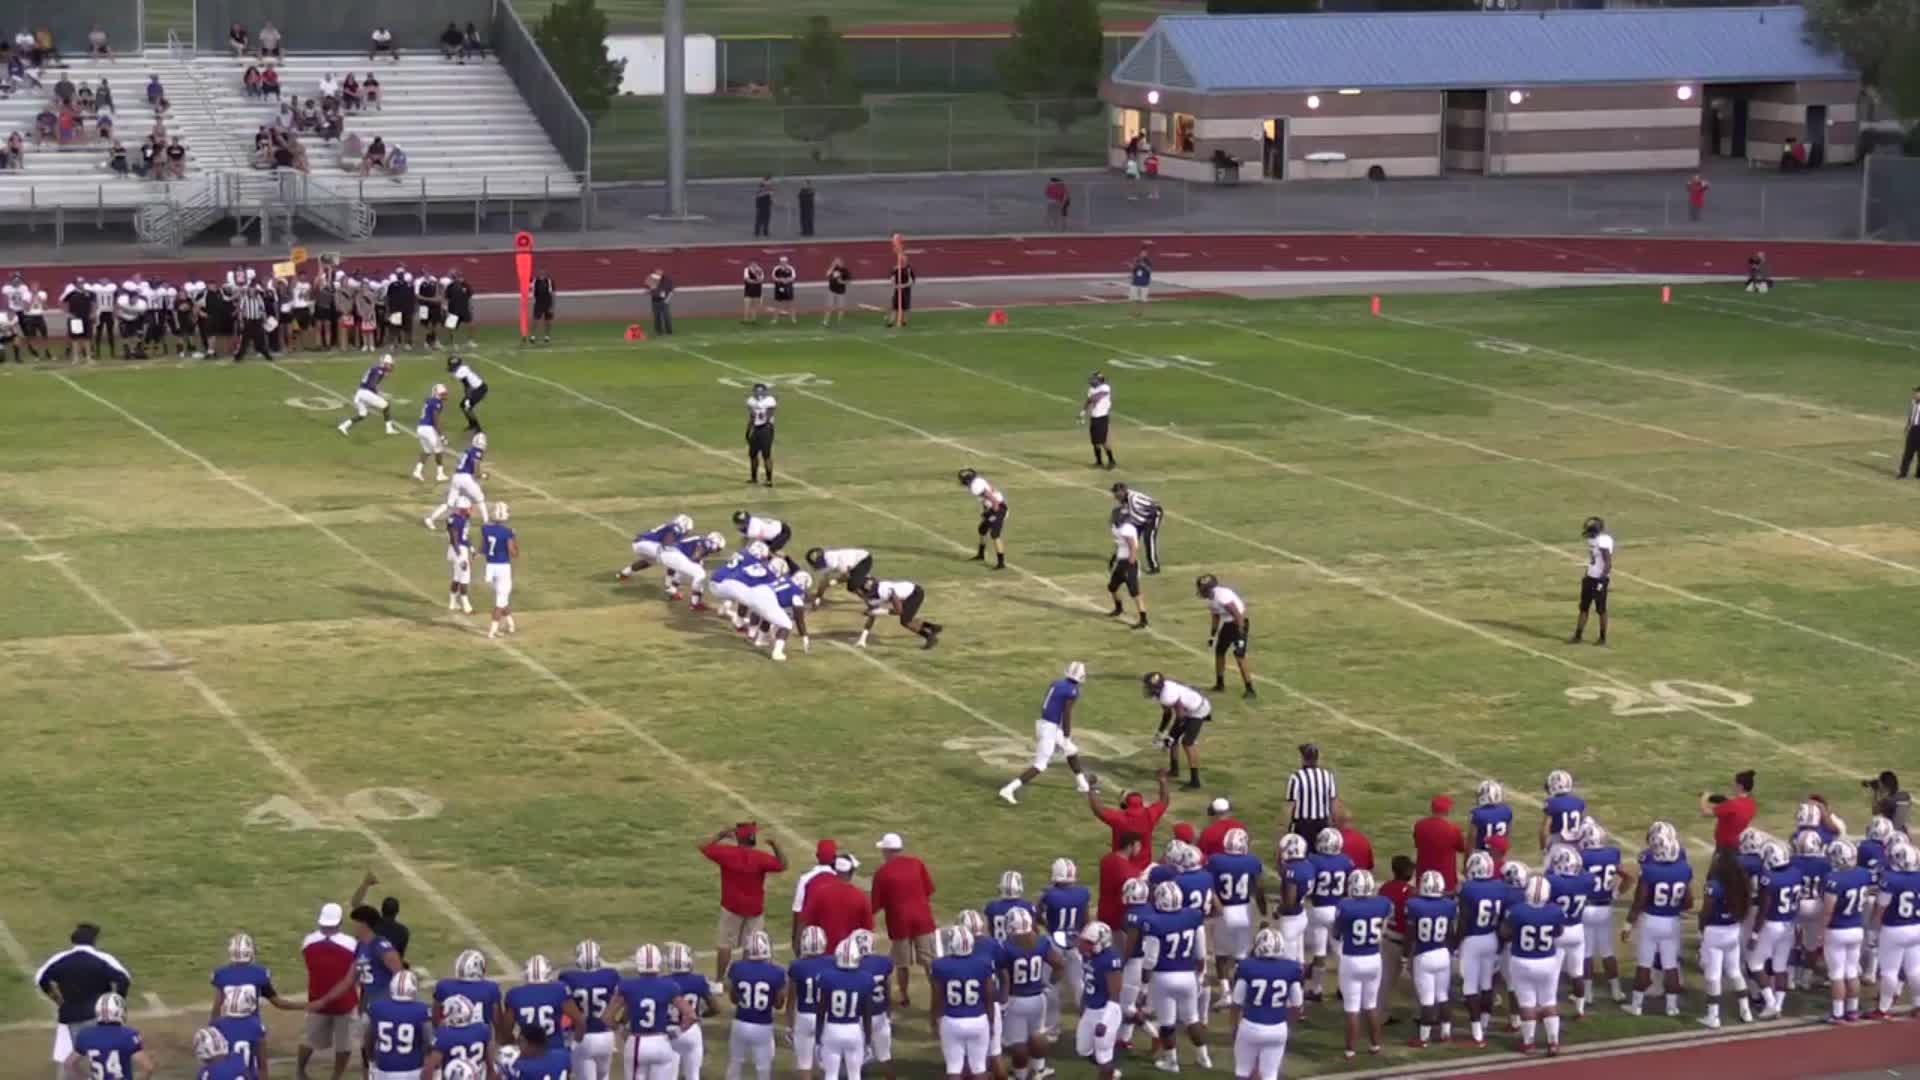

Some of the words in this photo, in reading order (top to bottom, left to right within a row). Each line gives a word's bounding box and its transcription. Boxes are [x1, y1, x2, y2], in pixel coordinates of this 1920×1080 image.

[488, 536, 497, 556] 7
[1564, 679, 1754, 716] 20
[244, 786, 444, 832] 40
[1219, 873, 1249, 900] 34
[1316, 871, 1346, 896] 23
[1059, 907, 1077, 929] 11
[1353, 917, 1382, 945] 95
[1418, 916, 1448, 942] 88
[1166, 929, 1195, 959] 77
[1521, 925, 1554, 951] 65
[1013, 955, 1042, 984] 60
[738, 981, 770, 1010] 36
[831, 989, 859, 1018] 81
[946, 979, 980, 1006] 66
[1251, 979, 1288, 1007] 72
[639, 998, 656, 1028] 3
[378, 1021, 415, 1054] 59
[87, 1049, 124, 1080] 54
